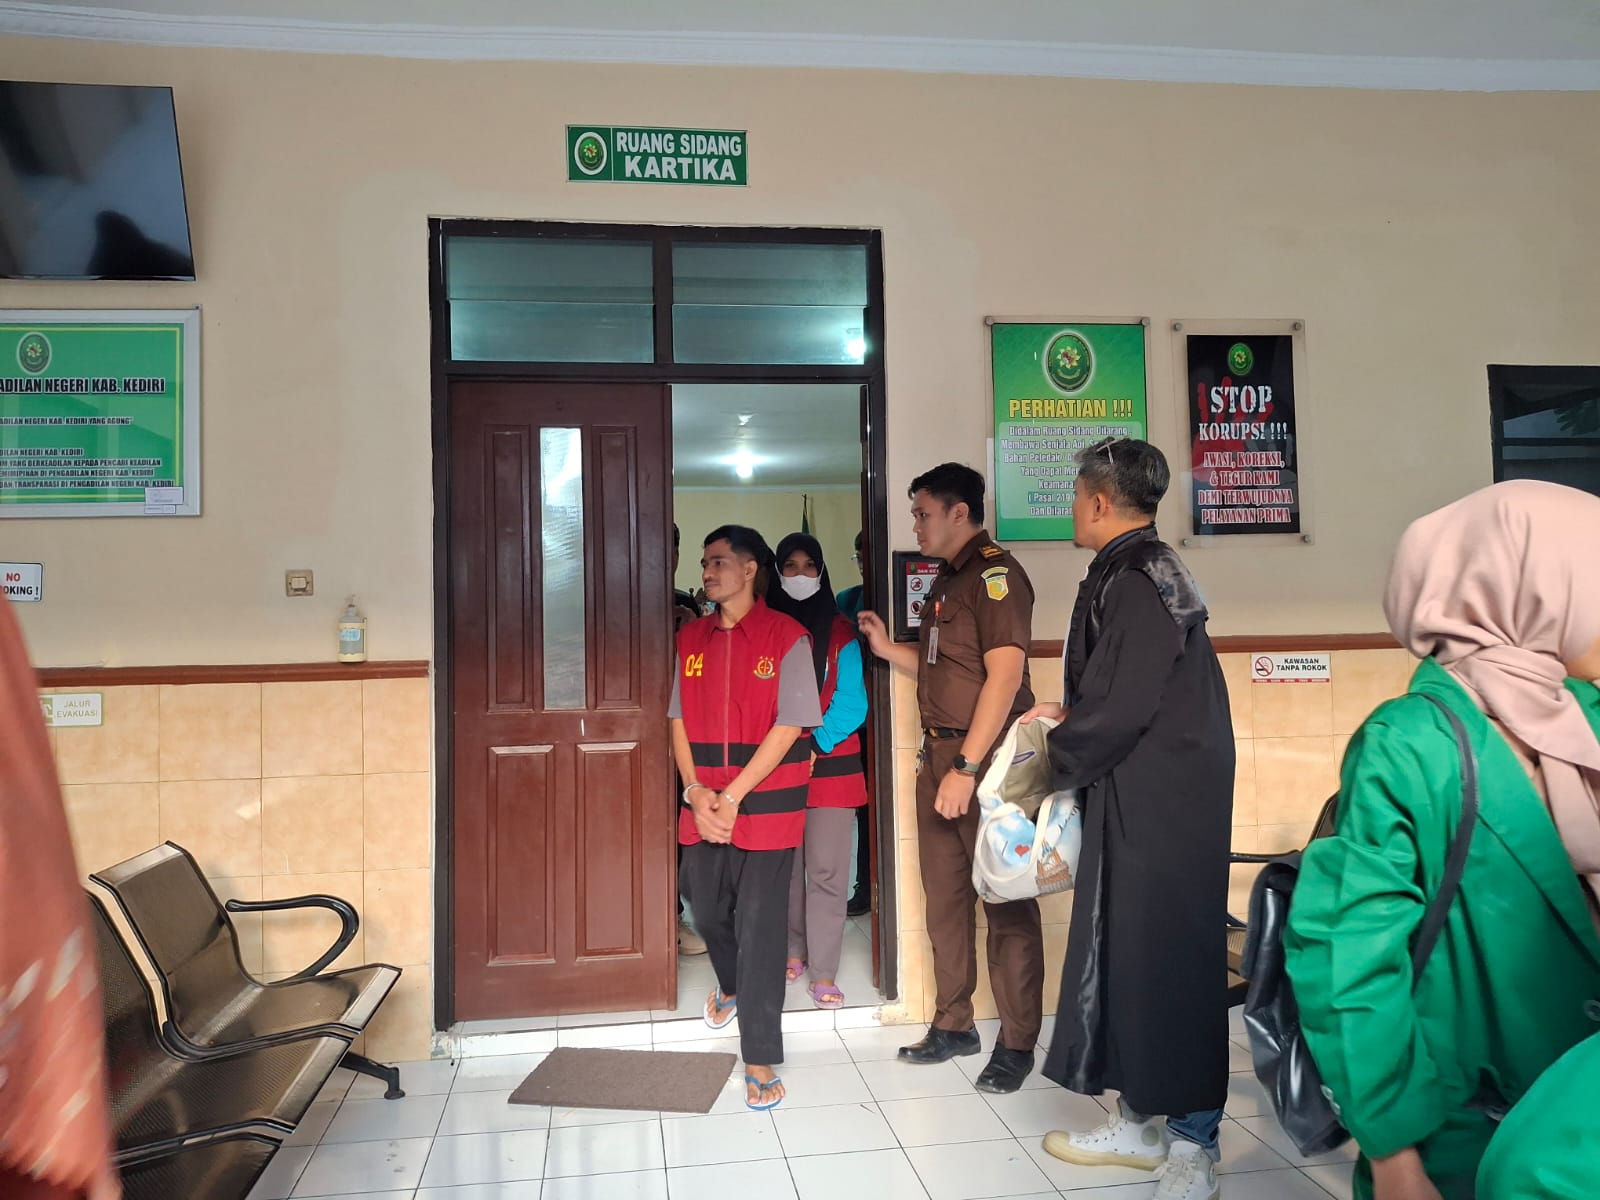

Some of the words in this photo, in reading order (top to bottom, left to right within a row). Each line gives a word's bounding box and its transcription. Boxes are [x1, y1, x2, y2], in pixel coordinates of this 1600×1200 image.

[616, 131, 674, 154] RUANG
[680, 134, 742, 157] SIDANG
[625, 155, 737, 181] KARTIKA
[44, 378, 89, 393] NEGERI
[92, 378, 121, 393] KAB.
[123, 378, 166, 393] KEDIRI
[1210, 385, 1272, 413] STOP
[1008, 398, 1107, 418] PERHATIAN
[1112, 399, 1132, 418] !!!
[24, 417, 48, 425] NEGERI
[66, 417, 88, 425] KEDIRI
[89, 417, 106, 425] YANG
[1009, 426, 1040, 436] Didalam
[1043, 426, 1067, 438] Ruang
[1068, 426, 1094, 438] Sidang
[1199, 422, 1265, 440] KORUPSI
[1270, 422, 1287, 440] !!!
[1001, 439, 1040, 449] Membawa
[1042, 439, 1071, 450] Senjata
[20, 448, 43, 456] NEGERI
[61, 448, 84, 456] KEDIRI
[73, 459, 99, 467] KEPADA
[1203, 451, 1236, 469] AWASI,
[1237, 451, 1285, 468] KOREKSI,
[48, 469, 89, 477] PENGADILAN
[90, 469, 114, 477] NEGERI
[132, 469, 154, 477] KEDIRI
[1021, 466, 1040, 477] Yang
[1041, 466, 1062, 477] Dapat
[1209, 471, 1219, 486] &
[1220, 470, 1252, 486] TEGUR
[1254, 470, 1280, 486] KAMI
[69, 480, 110, 488] PENGADILAN
[111, 480, 135, 488] NEGERI
[152, 480, 174, 488] KEDIRI
[1198, 489, 1222, 505] DEMI
[1223, 489, 1293, 506] TERWUJUDNYA
[1201, 508, 1256, 524] PELAYANAN
[1257, 507, 1291, 523] PRIMA
[6, 573, 21, 582] NO
[685, 653, 704, 677] 04
[64, 700, 91, 708] JALUR
[56, 710, 98, 718] EVAKUASI
